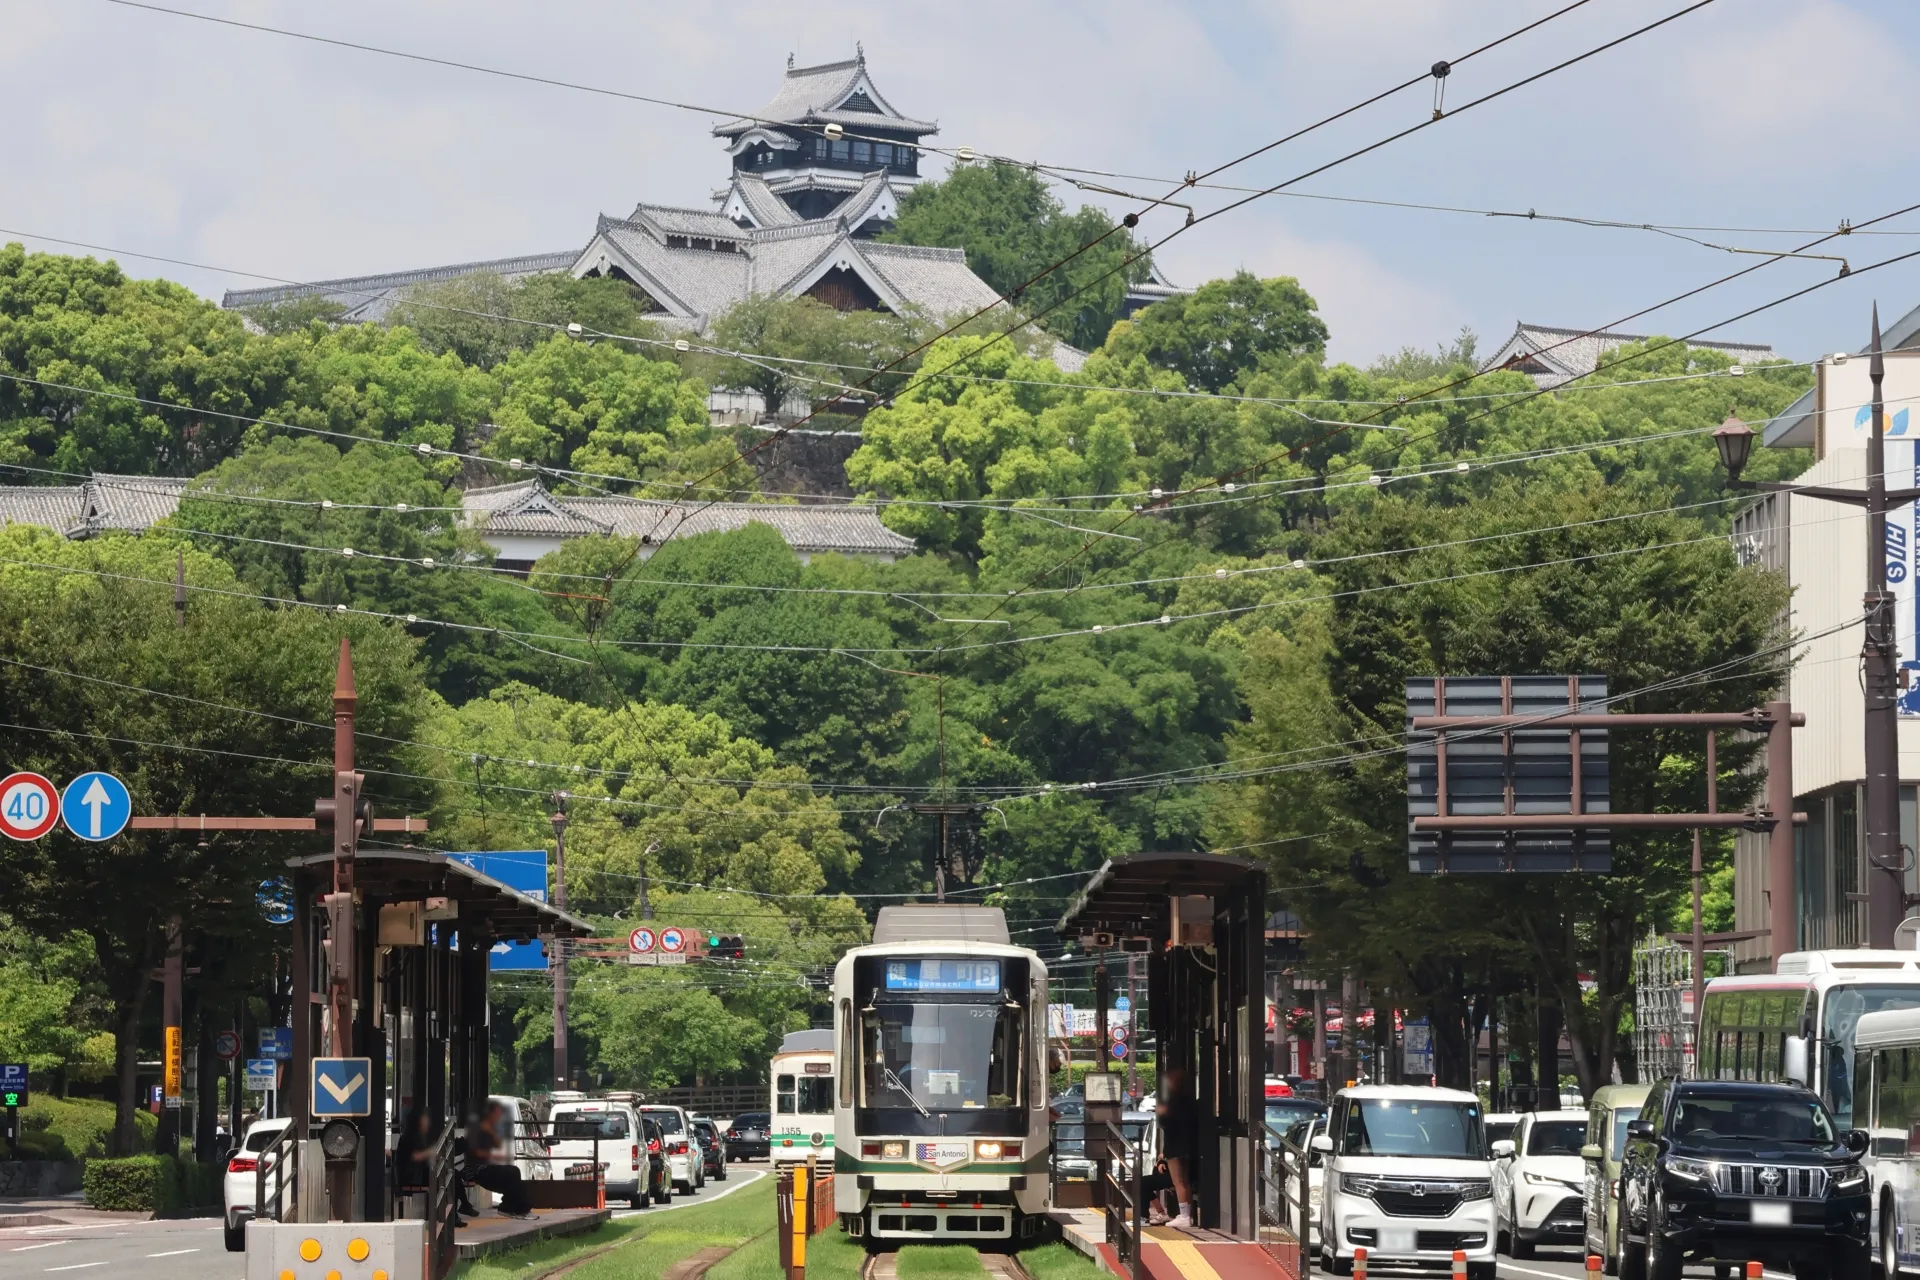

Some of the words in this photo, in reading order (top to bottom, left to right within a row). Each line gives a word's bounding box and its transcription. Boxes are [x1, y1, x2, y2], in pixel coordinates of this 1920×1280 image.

[1886, 525, 1905, 580] HIS
[7, 792, 43, 821] 40
[970, 1009, 1001, 1018] ワンマン
[5, 1065, 20, 1079] P
[5, 1093, 18, 1106] 空
[781, 1126, 802, 1136] 1355
[928, 1150, 941, 1158] San
[941, 1150, 966, 1158] Antonio
